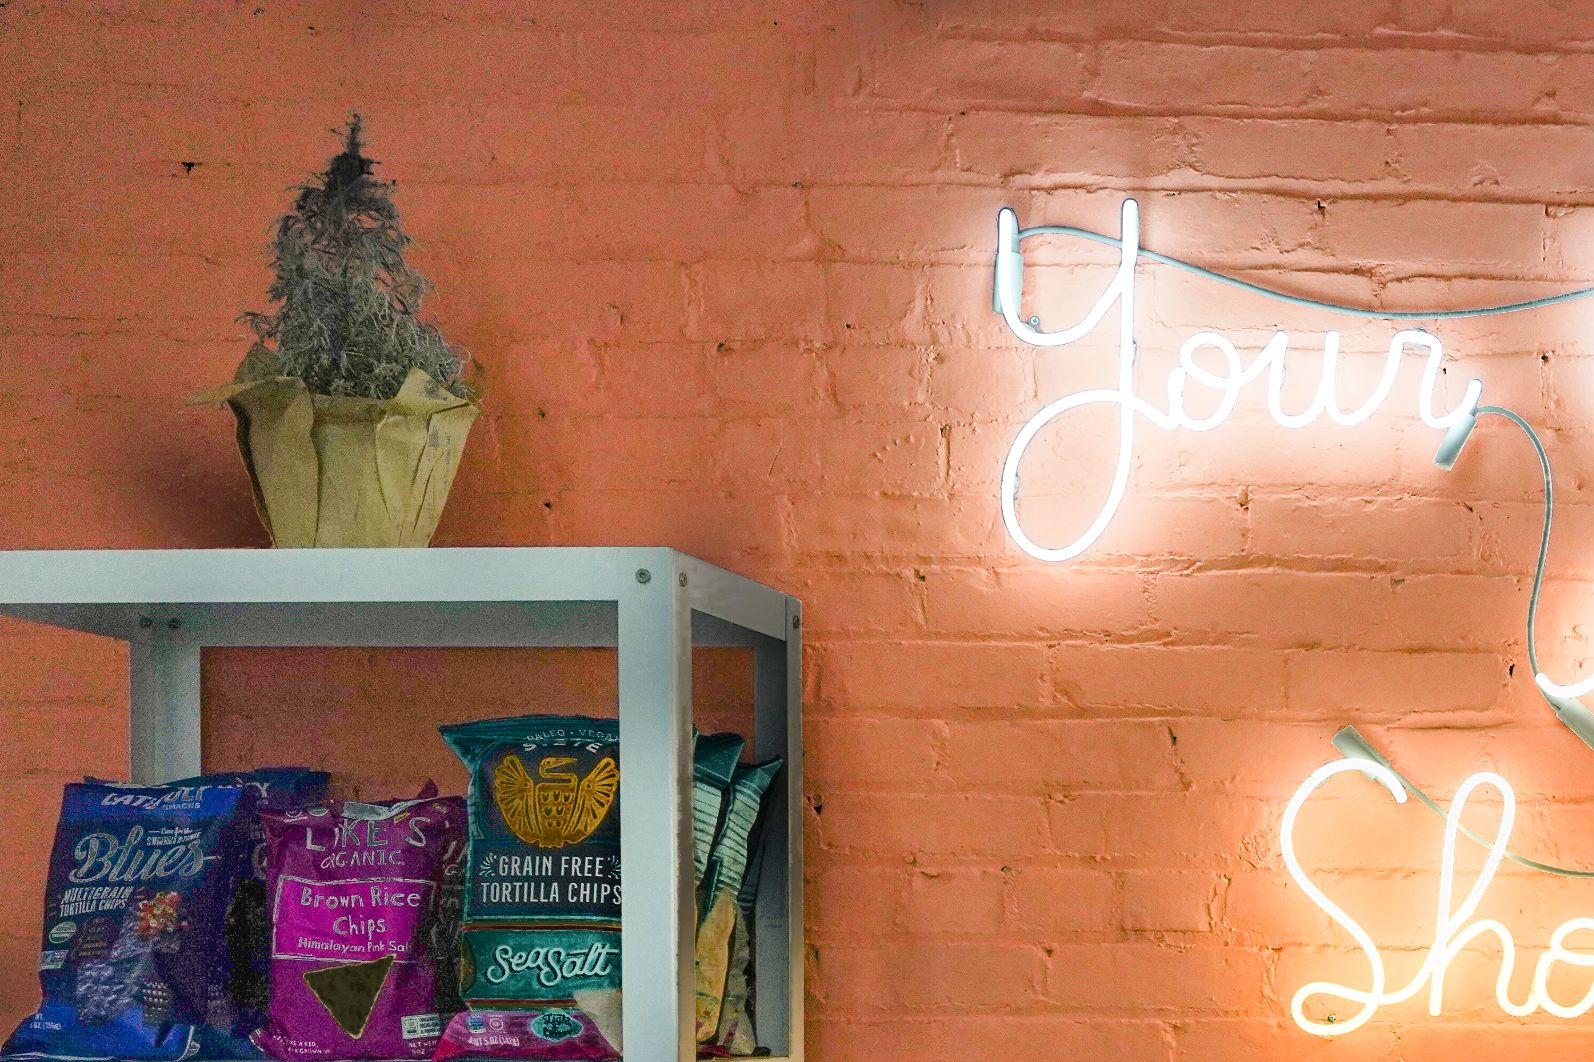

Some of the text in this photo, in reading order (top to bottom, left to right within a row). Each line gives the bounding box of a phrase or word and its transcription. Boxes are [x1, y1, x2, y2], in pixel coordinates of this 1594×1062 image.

[998, 198, 1484, 562] Your
[68, 825, 206, 884] Blues
[499, 856, 604, 878] GRAIN FREE
[301, 885, 422, 909] Brown Rice
[481, 882, 622, 905] TORTILLA CHIPS
[333, 915, 387, 941] Chips
[298, 937, 366, 954] Himalayan
[485, 941, 621, 989] Sea Salt
